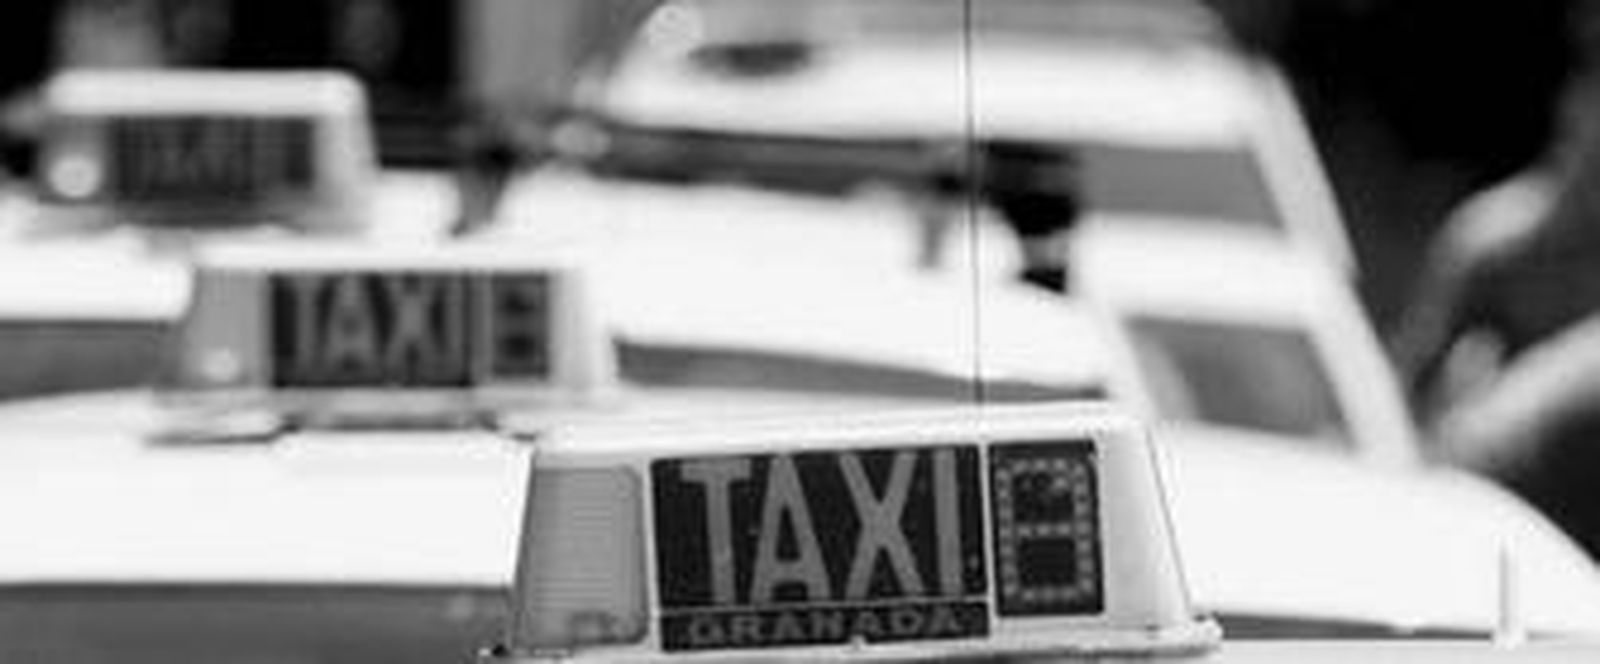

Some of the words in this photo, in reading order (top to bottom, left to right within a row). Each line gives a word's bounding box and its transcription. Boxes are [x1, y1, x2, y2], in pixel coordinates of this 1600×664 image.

[286, 272, 466, 378] TAXI
[681, 449, 962, 605] TAXI
[690, 606, 962, 646] GRANADA
